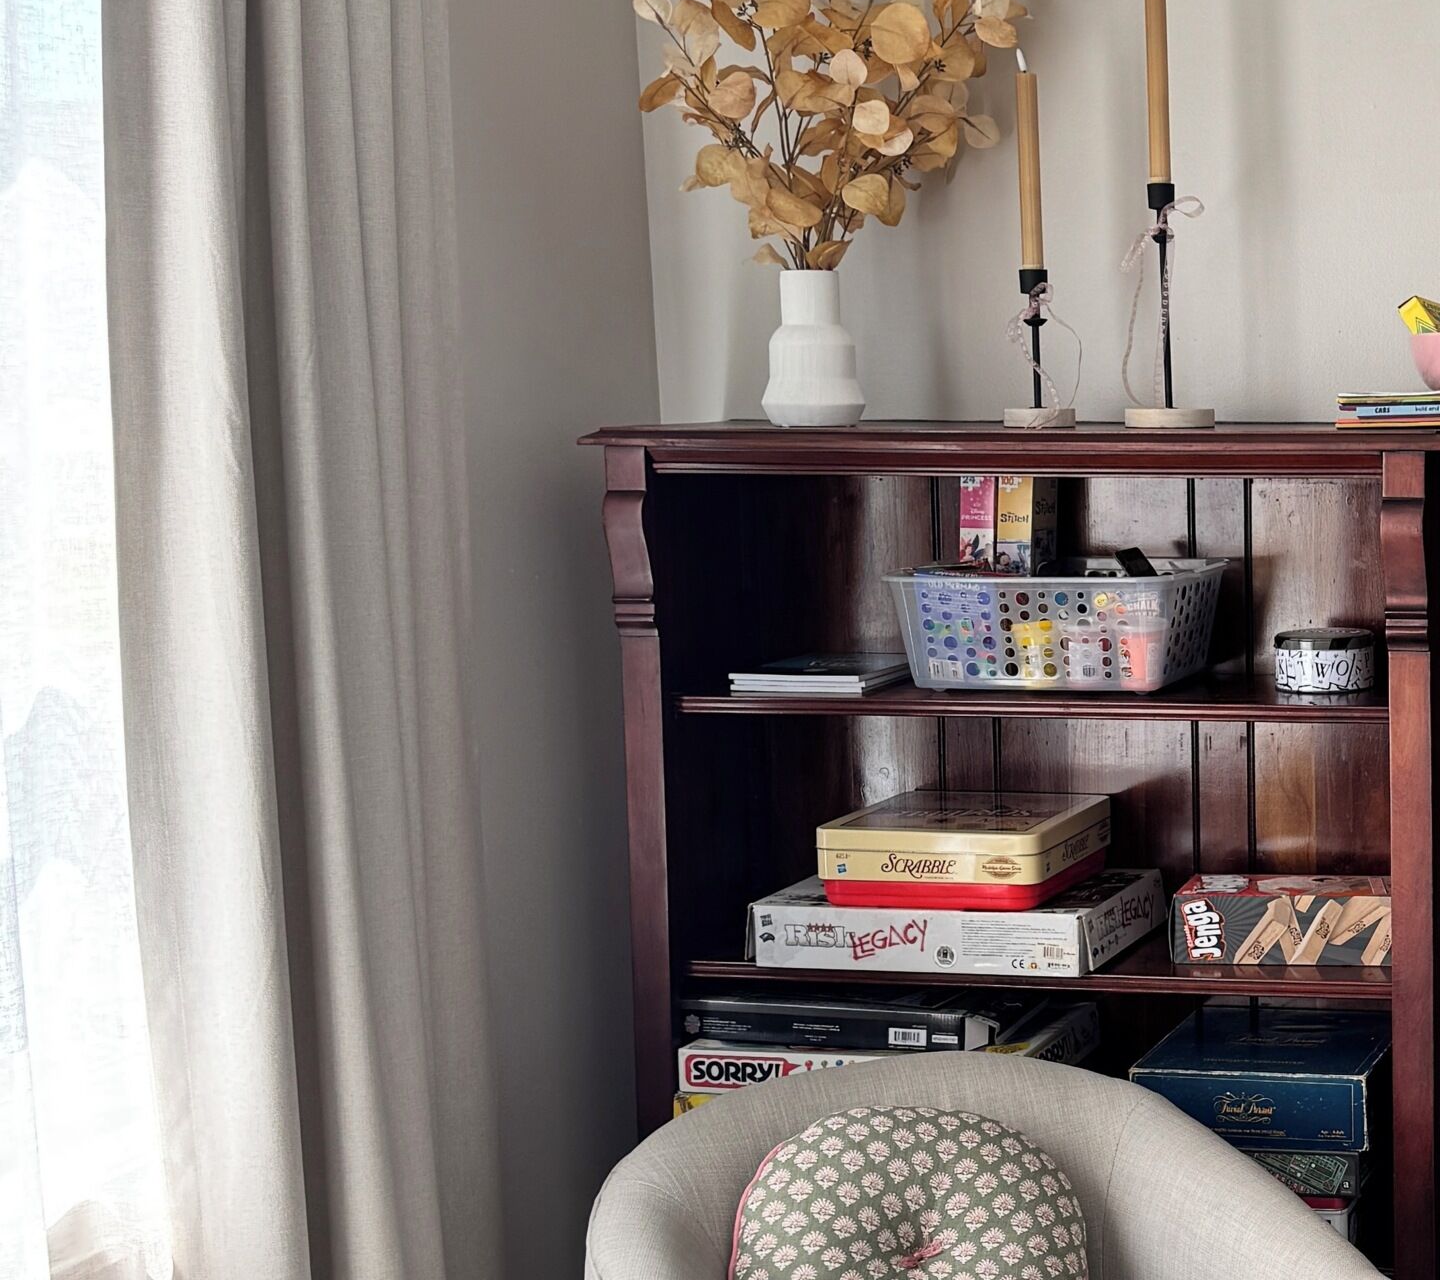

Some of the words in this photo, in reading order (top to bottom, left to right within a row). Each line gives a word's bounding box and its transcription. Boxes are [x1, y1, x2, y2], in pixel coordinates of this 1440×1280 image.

[881, 853, 957, 880] SCRABBLE
[849, 919, 927, 961] LEGACY
[1183, 900, 1222, 958] Jenga
[692, 1061, 781, 1083] SORRY!
